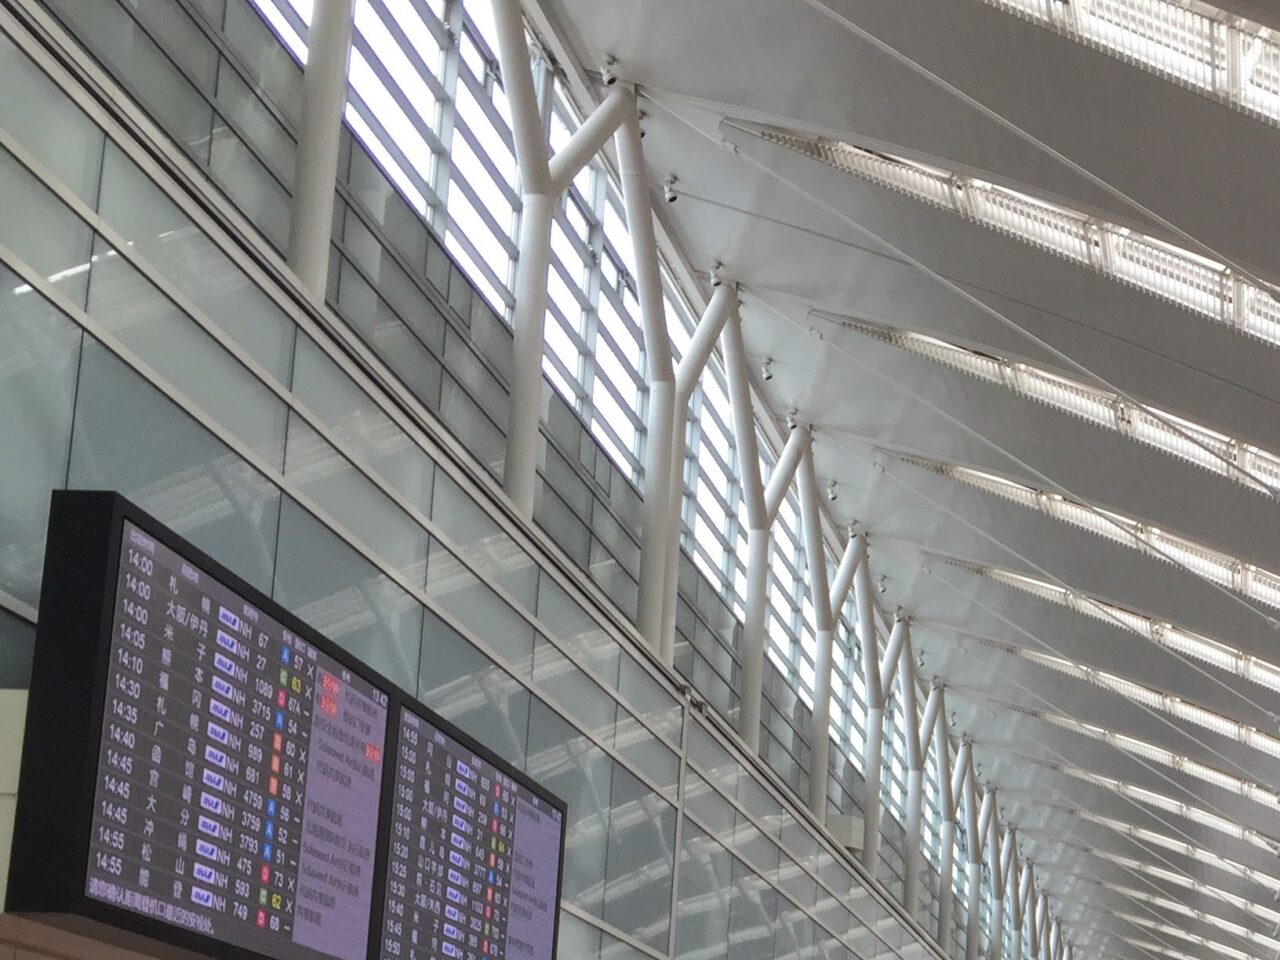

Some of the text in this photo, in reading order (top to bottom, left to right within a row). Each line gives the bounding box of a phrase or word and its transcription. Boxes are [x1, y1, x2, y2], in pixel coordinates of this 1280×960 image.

[121, 597, 147, 627] 14:00
[234, 664, 247, 685] NH
[287, 696, 301, 716] 67A
[124, 572, 150, 602] 14:00
[236, 641, 249, 662] NH
[255, 653, 266, 673] 27
[291, 675, 301, 694] 63
[127, 547, 152, 578] 14:00
[238, 619, 251, 640] NH
[258, 631, 268, 651] 67
[293, 654, 303, 673] 57
[114, 672, 140, 700] 14:30
[227, 732, 241, 753] NH
[283, 762, 293, 780] 61
[116, 647, 142, 676] 14:10
[229, 710, 243, 730] NH
[249, 720, 264, 742] 257
[285, 740, 295, 758] 60
[119, 622, 145, 651] 14:05
[232, 687, 245, 707] NH
[251, 698, 271, 722] 3715
[287, 719, 297, 737] 54
[108, 723, 134, 750] 14:40
[223, 778, 237, 798] NH
[243, 788, 262, 810] 4759
[111, 697, 137, 725] 14:35
[225, 755, 239, 775] NH
[100, 799, 127, 825] 14:45
[216, 848, 230, 867] NH
[236, 856, 252, 875] 475
[273, 871, 283, 888] 73
[103, 774, 129, 800] 14:45
[219, 824, 232, 844] NH
[239, 833, 258, 855] 3793
[275, 849, 285, 866] 51
[105, 748, 132, 775] 14:45
[221, 801, 234, 821] NH
[241, 811, 260, 832] 3759
[277, 827, 287, 845] 52
[95, 851, 121, 876] 14:55
[212, 894, 226, 913] NH
[232, 902, 248, 920] 749
[97, 825, 124, 850] 14:55
[214, 871, 228, 890] NH
[234, 879, 250, 898] 593
[271, 893, 281, 910] 62
